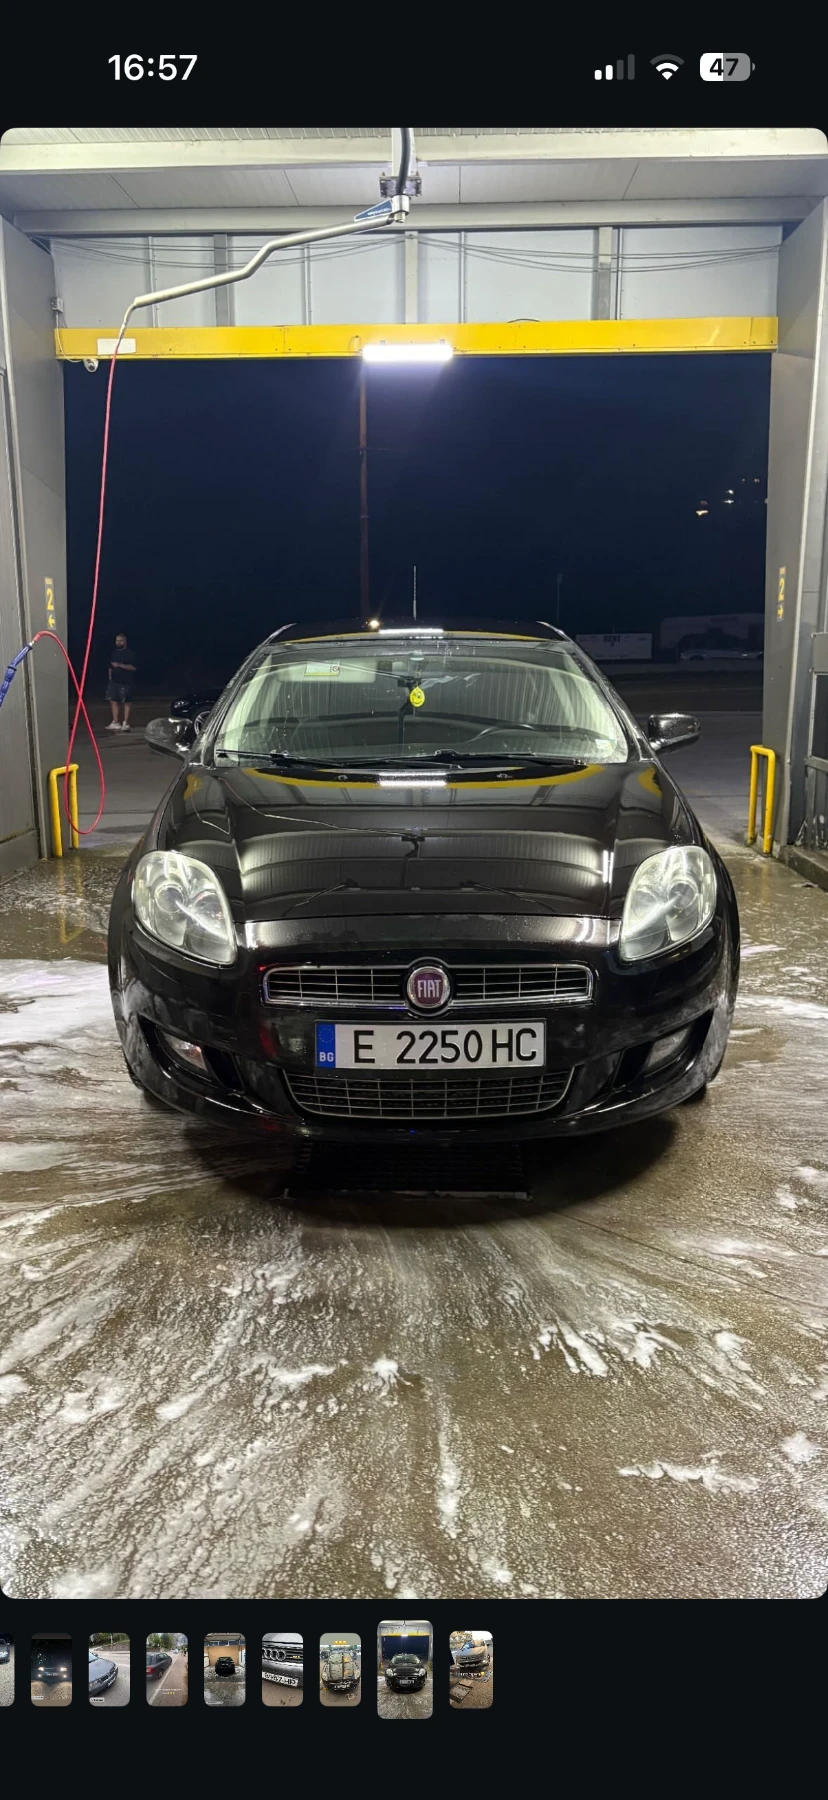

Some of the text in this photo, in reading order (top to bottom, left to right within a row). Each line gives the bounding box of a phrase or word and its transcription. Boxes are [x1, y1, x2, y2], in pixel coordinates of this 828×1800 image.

[46, 587, 55, 611] 2
[778, 577, 786, 602] 2
[417, 979, 442, 998] FIAT
[319, 1051, 334, 1063] BG
[353, 1028, 537, 1064] E 2250 HC
